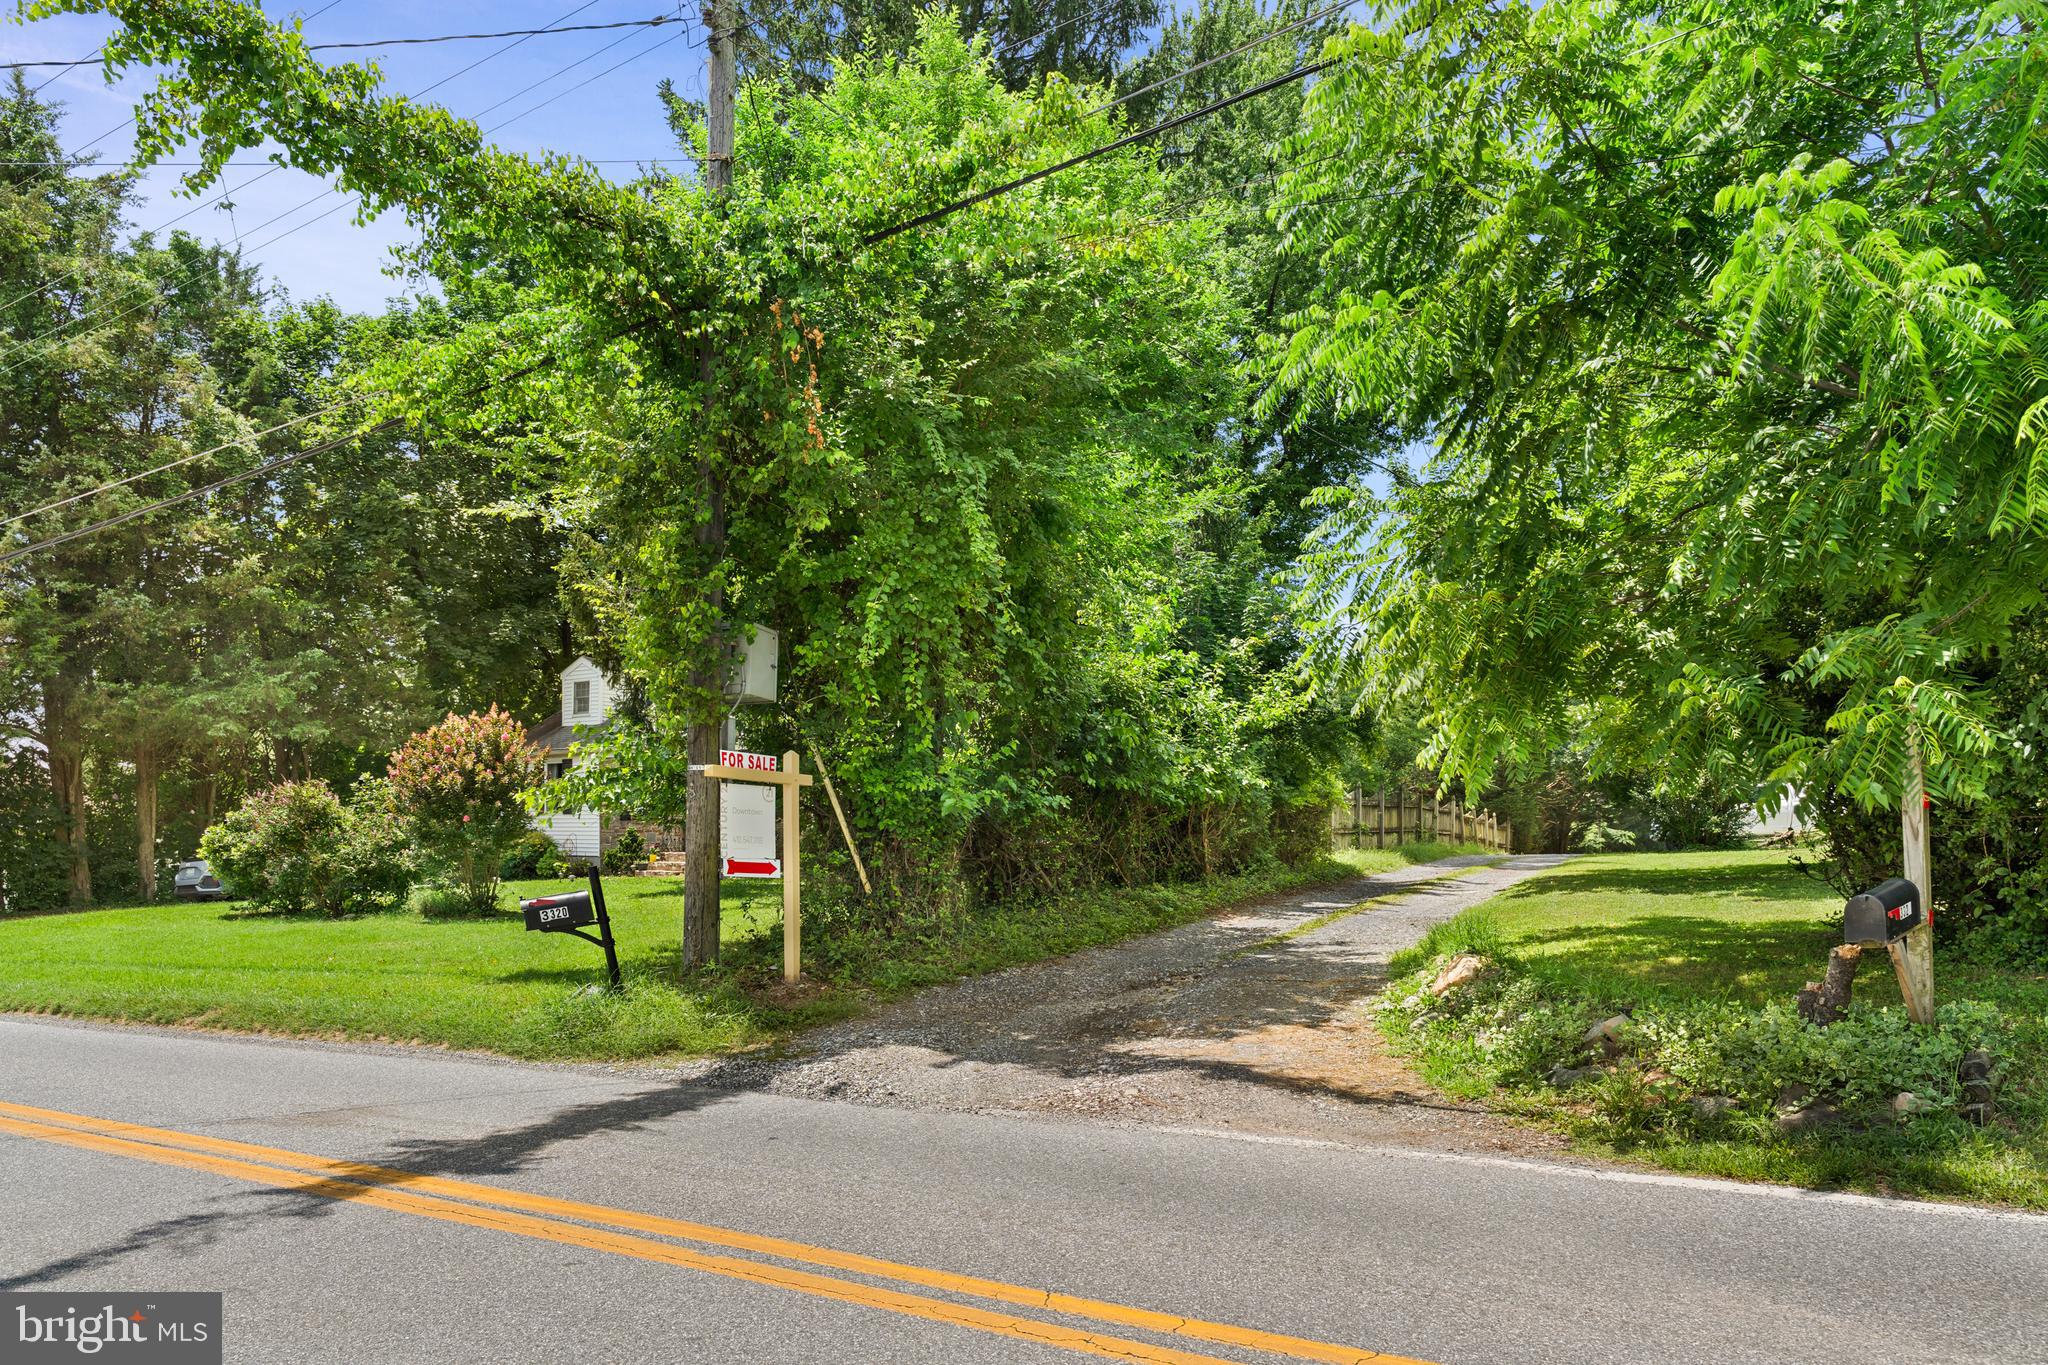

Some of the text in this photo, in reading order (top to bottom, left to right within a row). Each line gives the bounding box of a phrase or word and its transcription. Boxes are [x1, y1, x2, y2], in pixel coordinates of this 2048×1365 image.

[721, 752, 776, 771] FOR SALE
[541, 907, 568, 921] 3320
